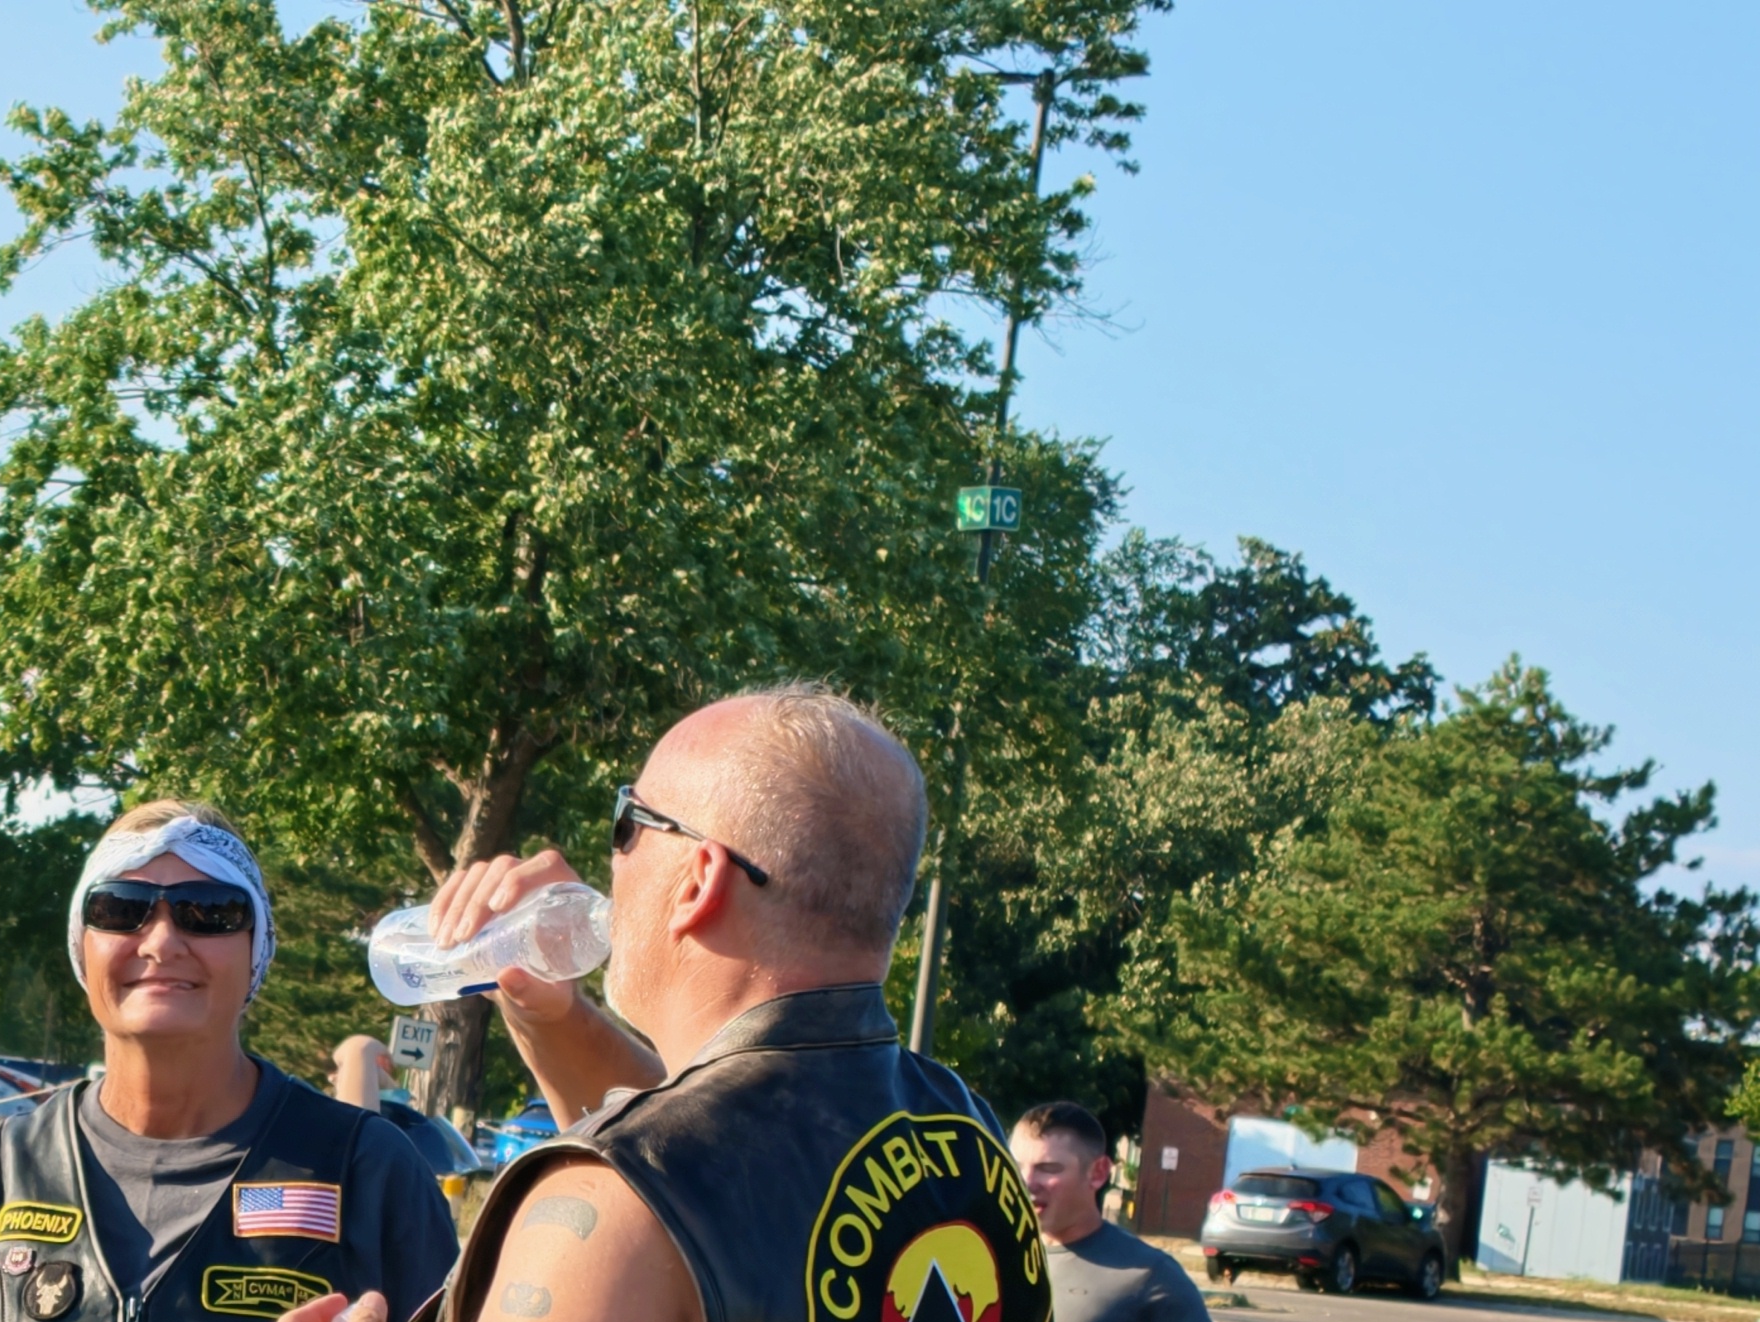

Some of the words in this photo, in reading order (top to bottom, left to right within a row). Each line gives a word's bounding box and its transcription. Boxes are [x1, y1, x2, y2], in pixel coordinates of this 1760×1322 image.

[993, 495, 1017, 523] 1C
[401, 1024, 434, 1045] EXIT
[0, 1209, 73, 1234] PHOENIX
[820, 1131, 959, 1320] COMBAT
[976, 1137, 1041, 1285] VETS
